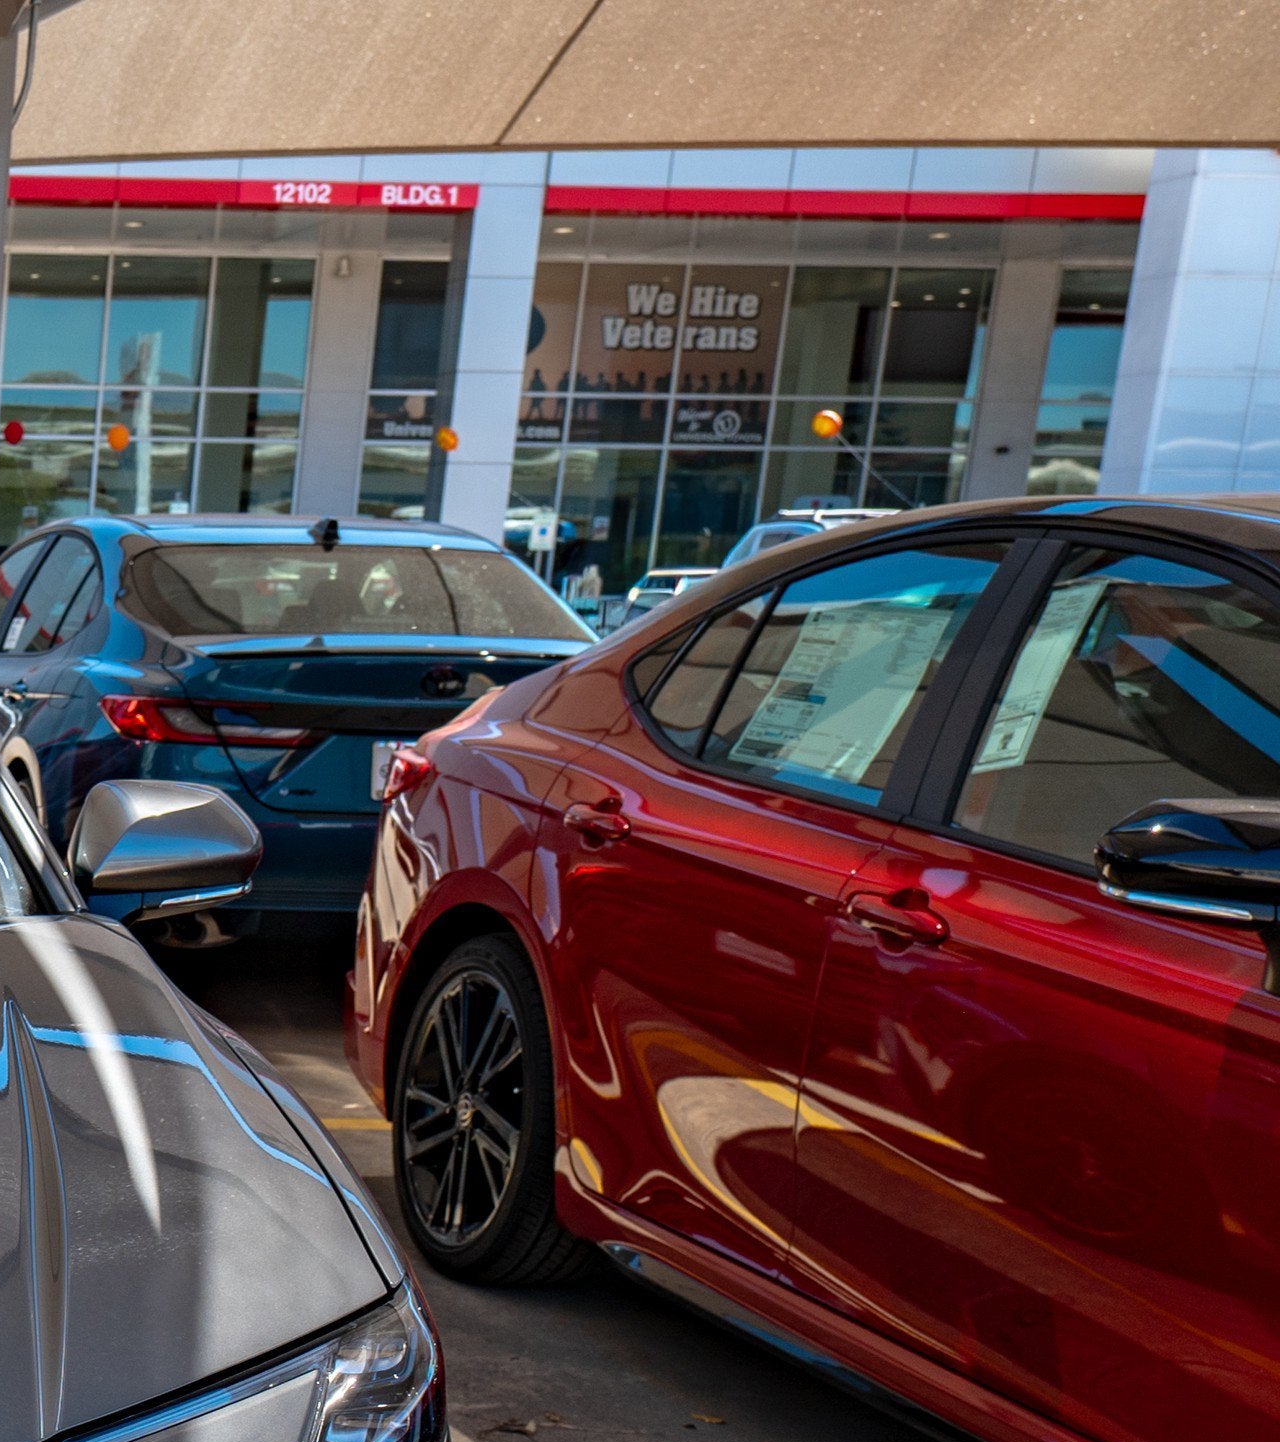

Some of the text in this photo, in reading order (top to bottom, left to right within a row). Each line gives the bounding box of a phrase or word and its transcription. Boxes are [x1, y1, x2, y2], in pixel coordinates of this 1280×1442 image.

[273, 183, 332, 204] 12102
[381, 185, 458, 205] BLDG. 1
[627, 283, 760, 319] We Hire
[602, 317, 759, 351] Veterans
